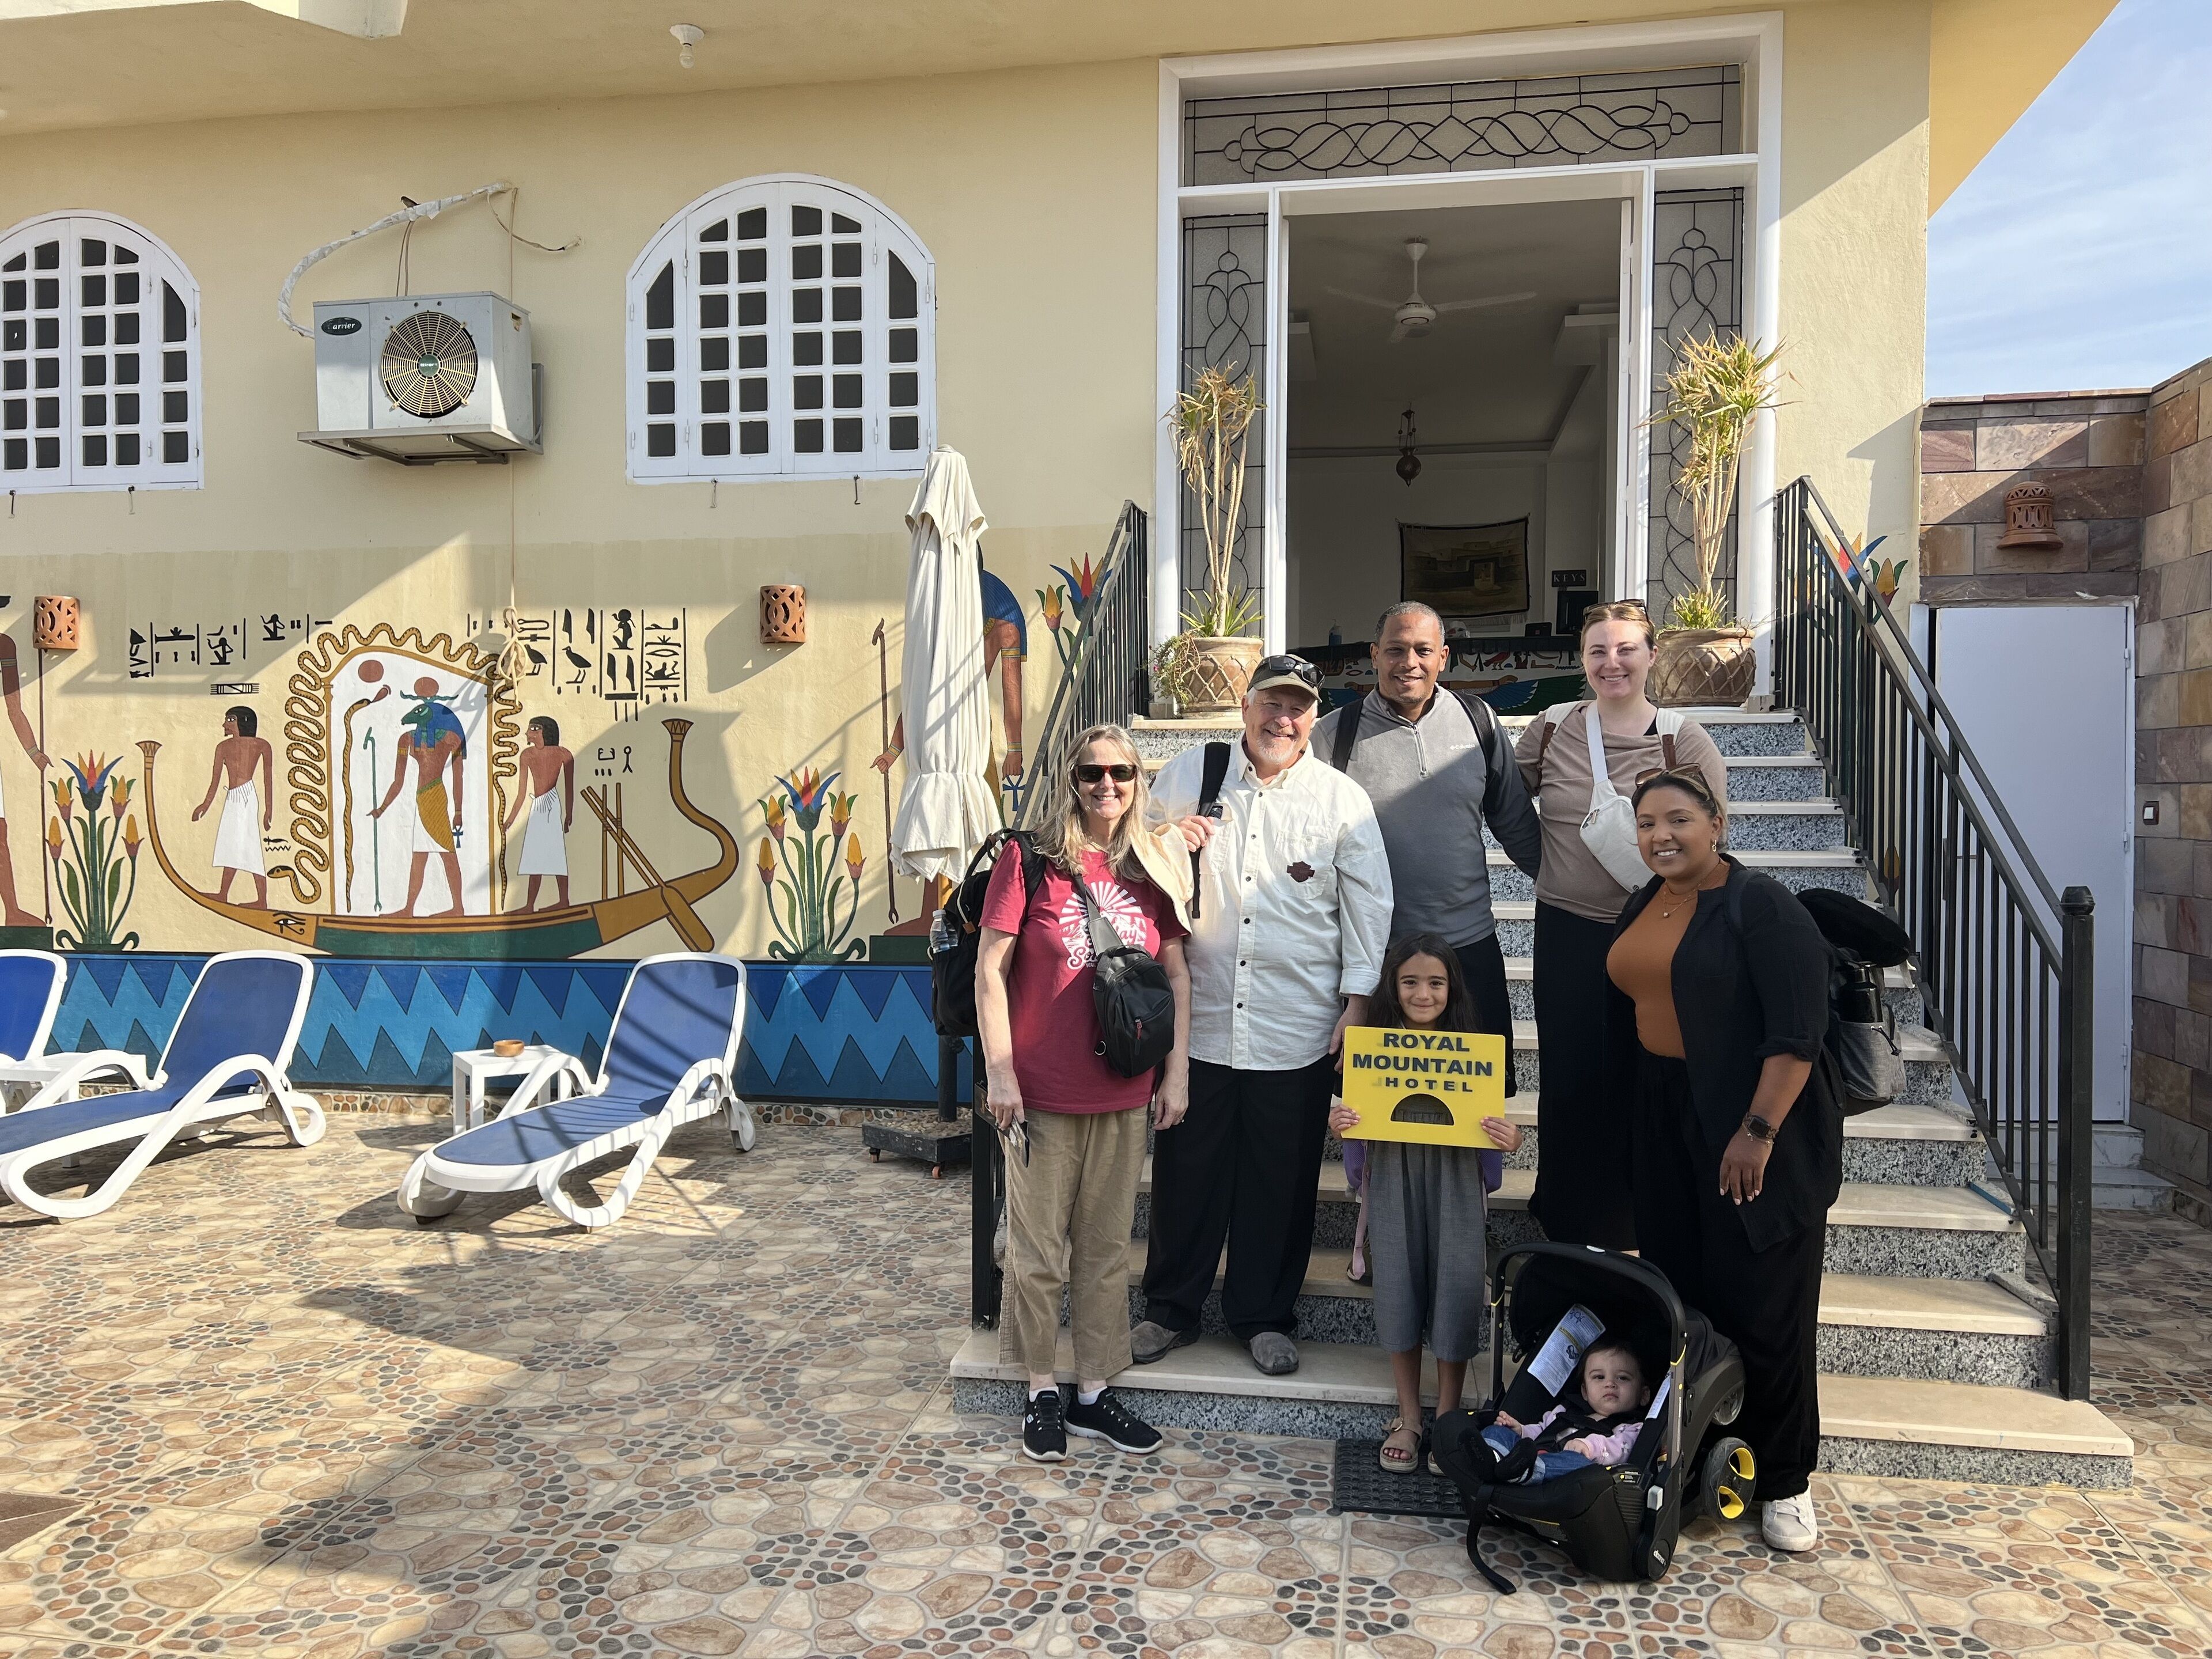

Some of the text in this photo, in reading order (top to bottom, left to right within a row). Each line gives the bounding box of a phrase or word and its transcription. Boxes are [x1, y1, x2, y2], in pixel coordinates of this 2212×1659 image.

[1554, 574, 1585, 582] KEYS
[1384, 1033, 1469, 1051] ROYAL
[1353, 1054, 1492, 1076] MOUNTAIN
[1385, 1077, 1472, 1092] HOTEL
